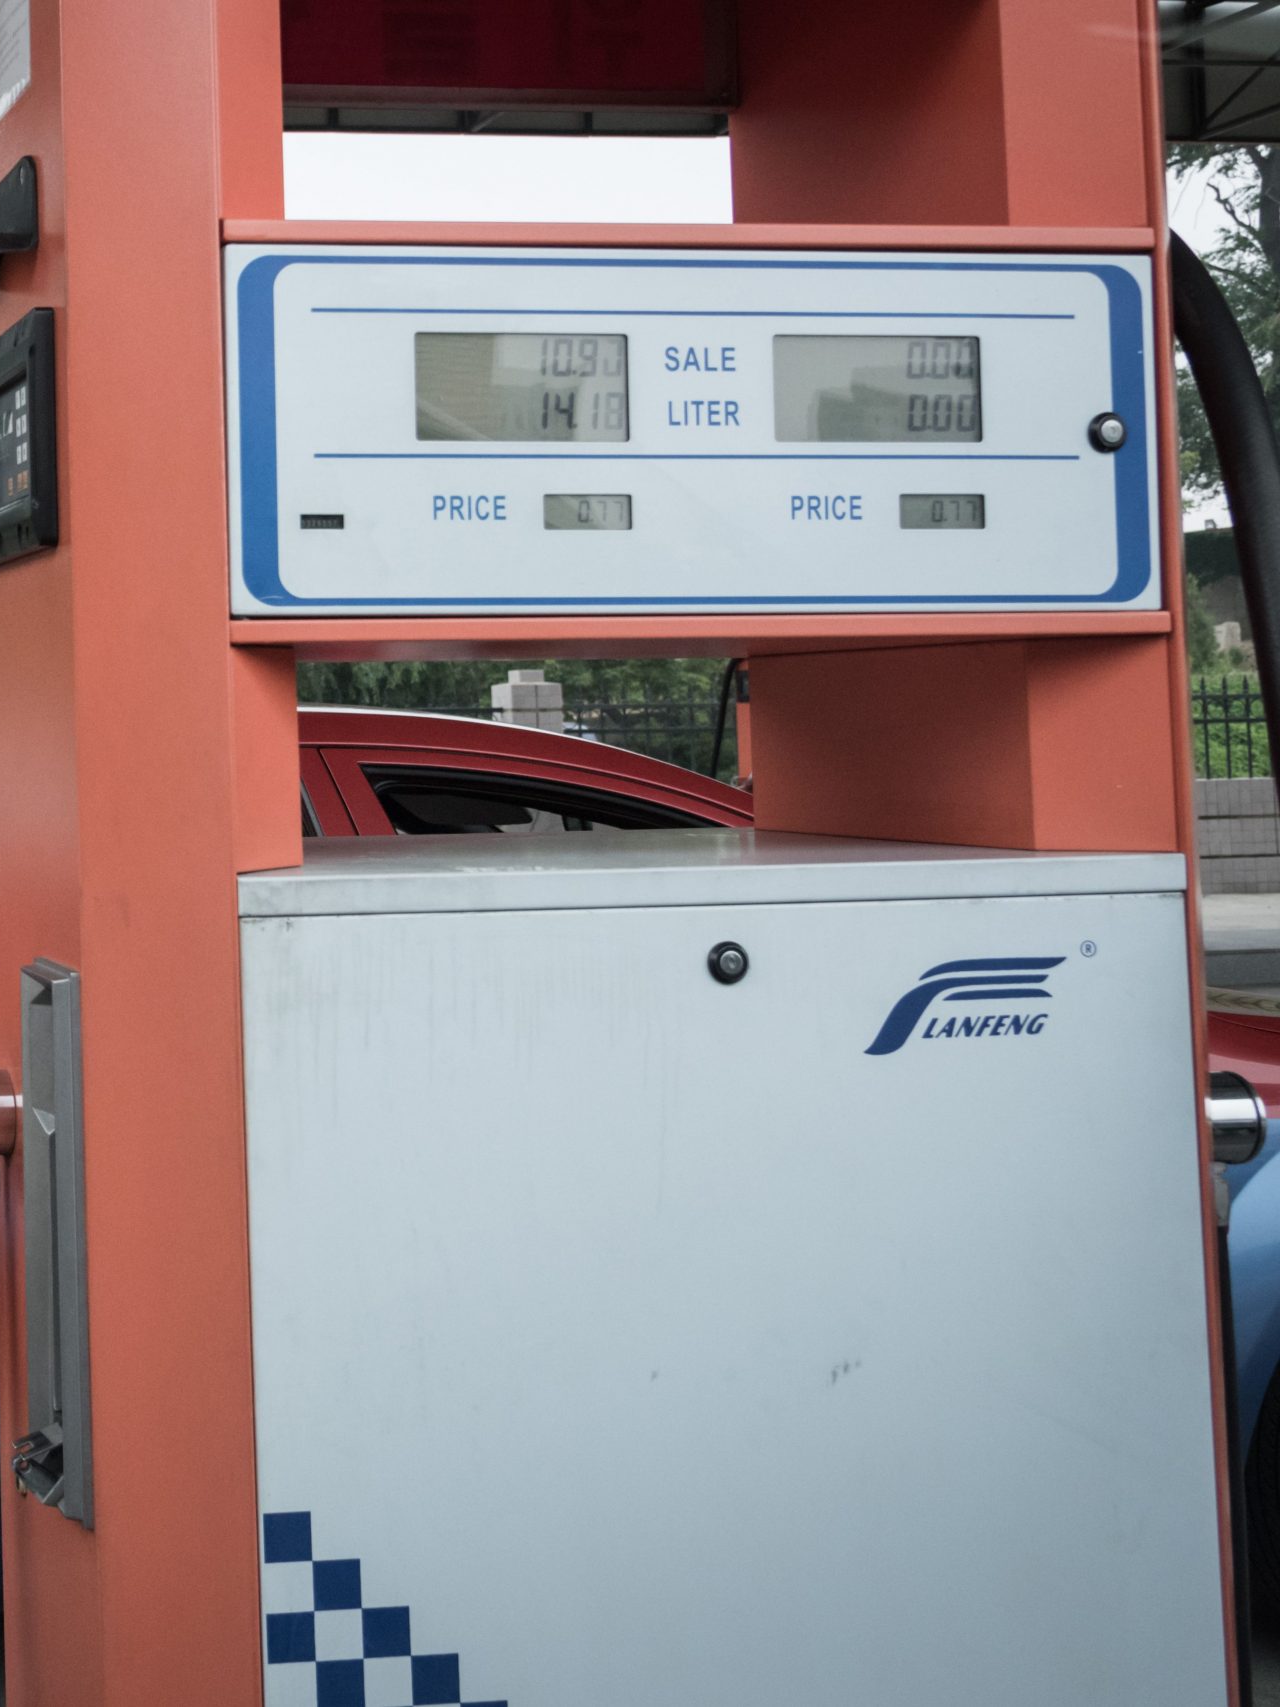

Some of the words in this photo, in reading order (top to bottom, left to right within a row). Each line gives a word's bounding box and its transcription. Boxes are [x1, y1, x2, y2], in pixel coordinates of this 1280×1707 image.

[664, 346, 736, 372] SALE
[906, 341, 975, 379] 0.00
[541, 391, 625, 430] 14.18
[668, 400, 740, 426] LITER
[907, 394, 977, 432] 0.00
[432, 495, 507, 521] PRICE
[791, 495, 863, 520] PRICE
[921, 1013, 1049, 1039] LANFENG
